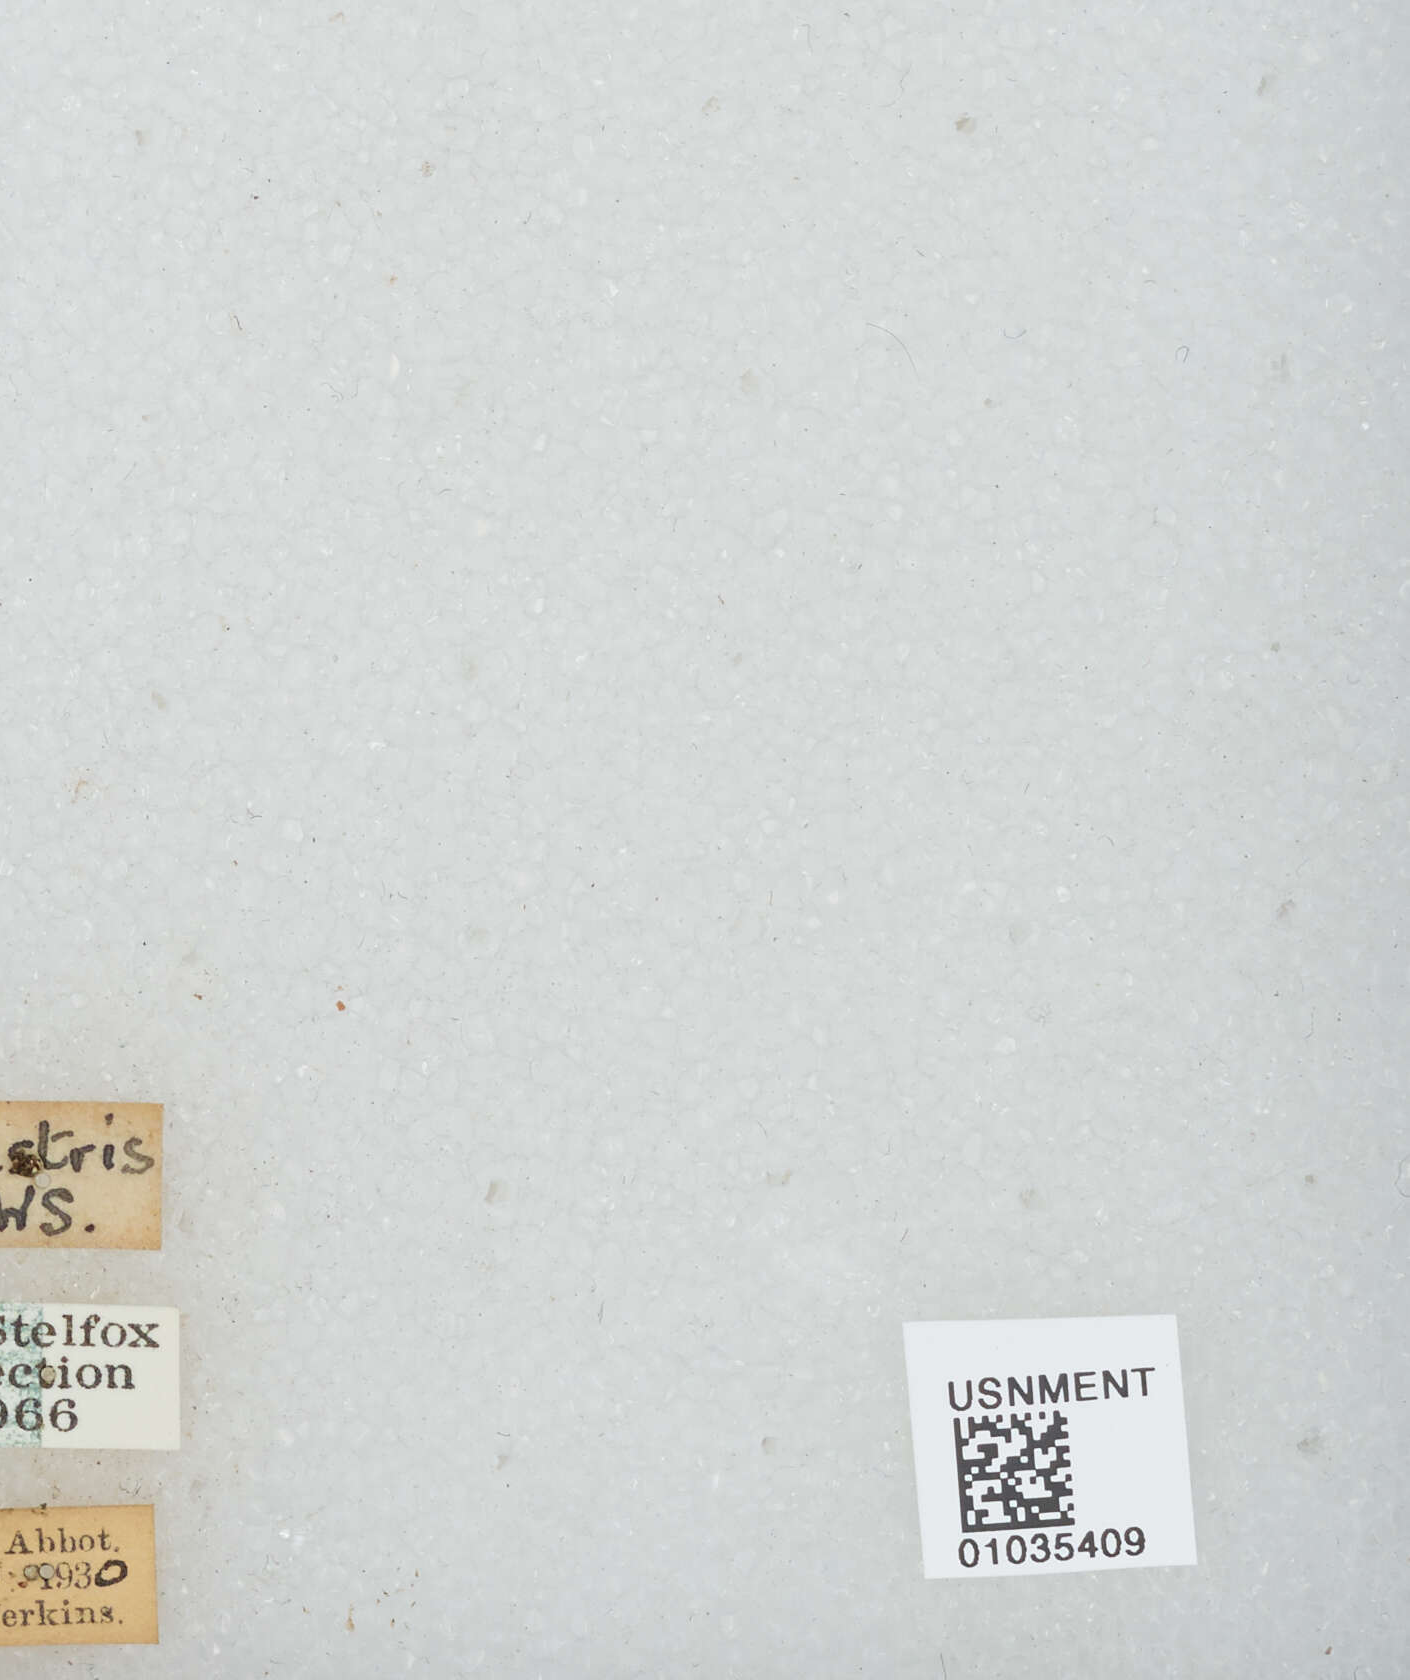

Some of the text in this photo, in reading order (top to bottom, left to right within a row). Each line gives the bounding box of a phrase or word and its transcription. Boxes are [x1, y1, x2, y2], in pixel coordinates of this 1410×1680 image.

[948, 1367, 1156, 1411] USNMENT
[4, 1528, 120, 1555] Abbot.
[958, 1526, 1146, 1568] 01035409
